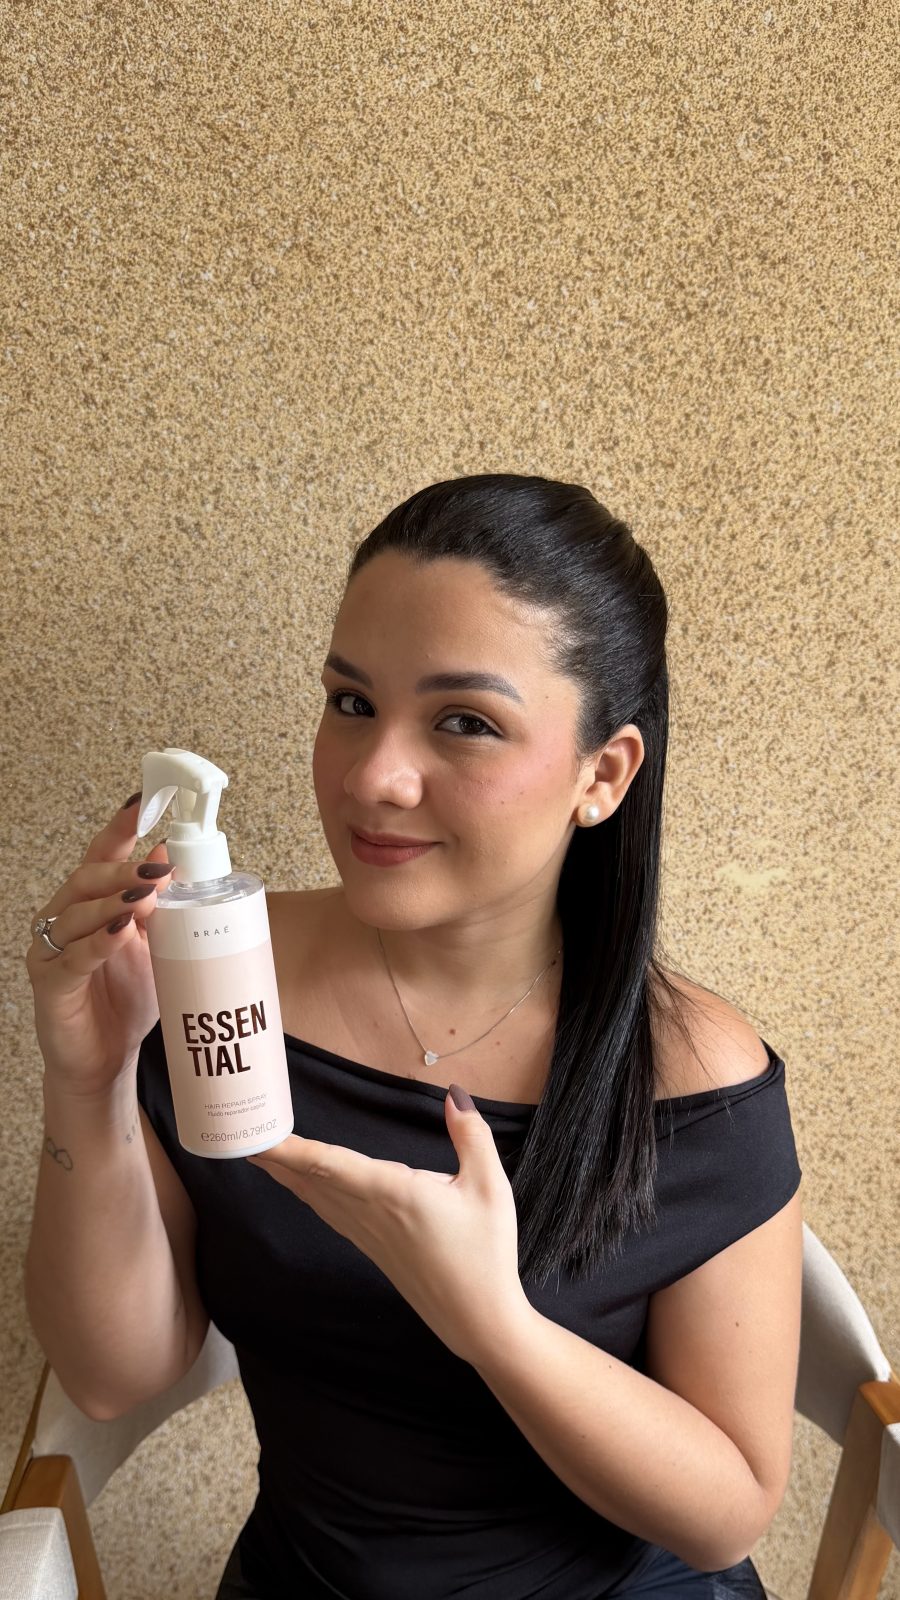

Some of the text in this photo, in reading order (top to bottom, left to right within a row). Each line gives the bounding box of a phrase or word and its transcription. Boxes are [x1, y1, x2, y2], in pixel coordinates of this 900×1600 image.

[193, 926, 230, 938] BRAÉ
[182, 1000, 267, 1044] ESSEN
[187, 1042, 252, 1077] TIAL
[221, 1099, 246, 1109] REPAIR
